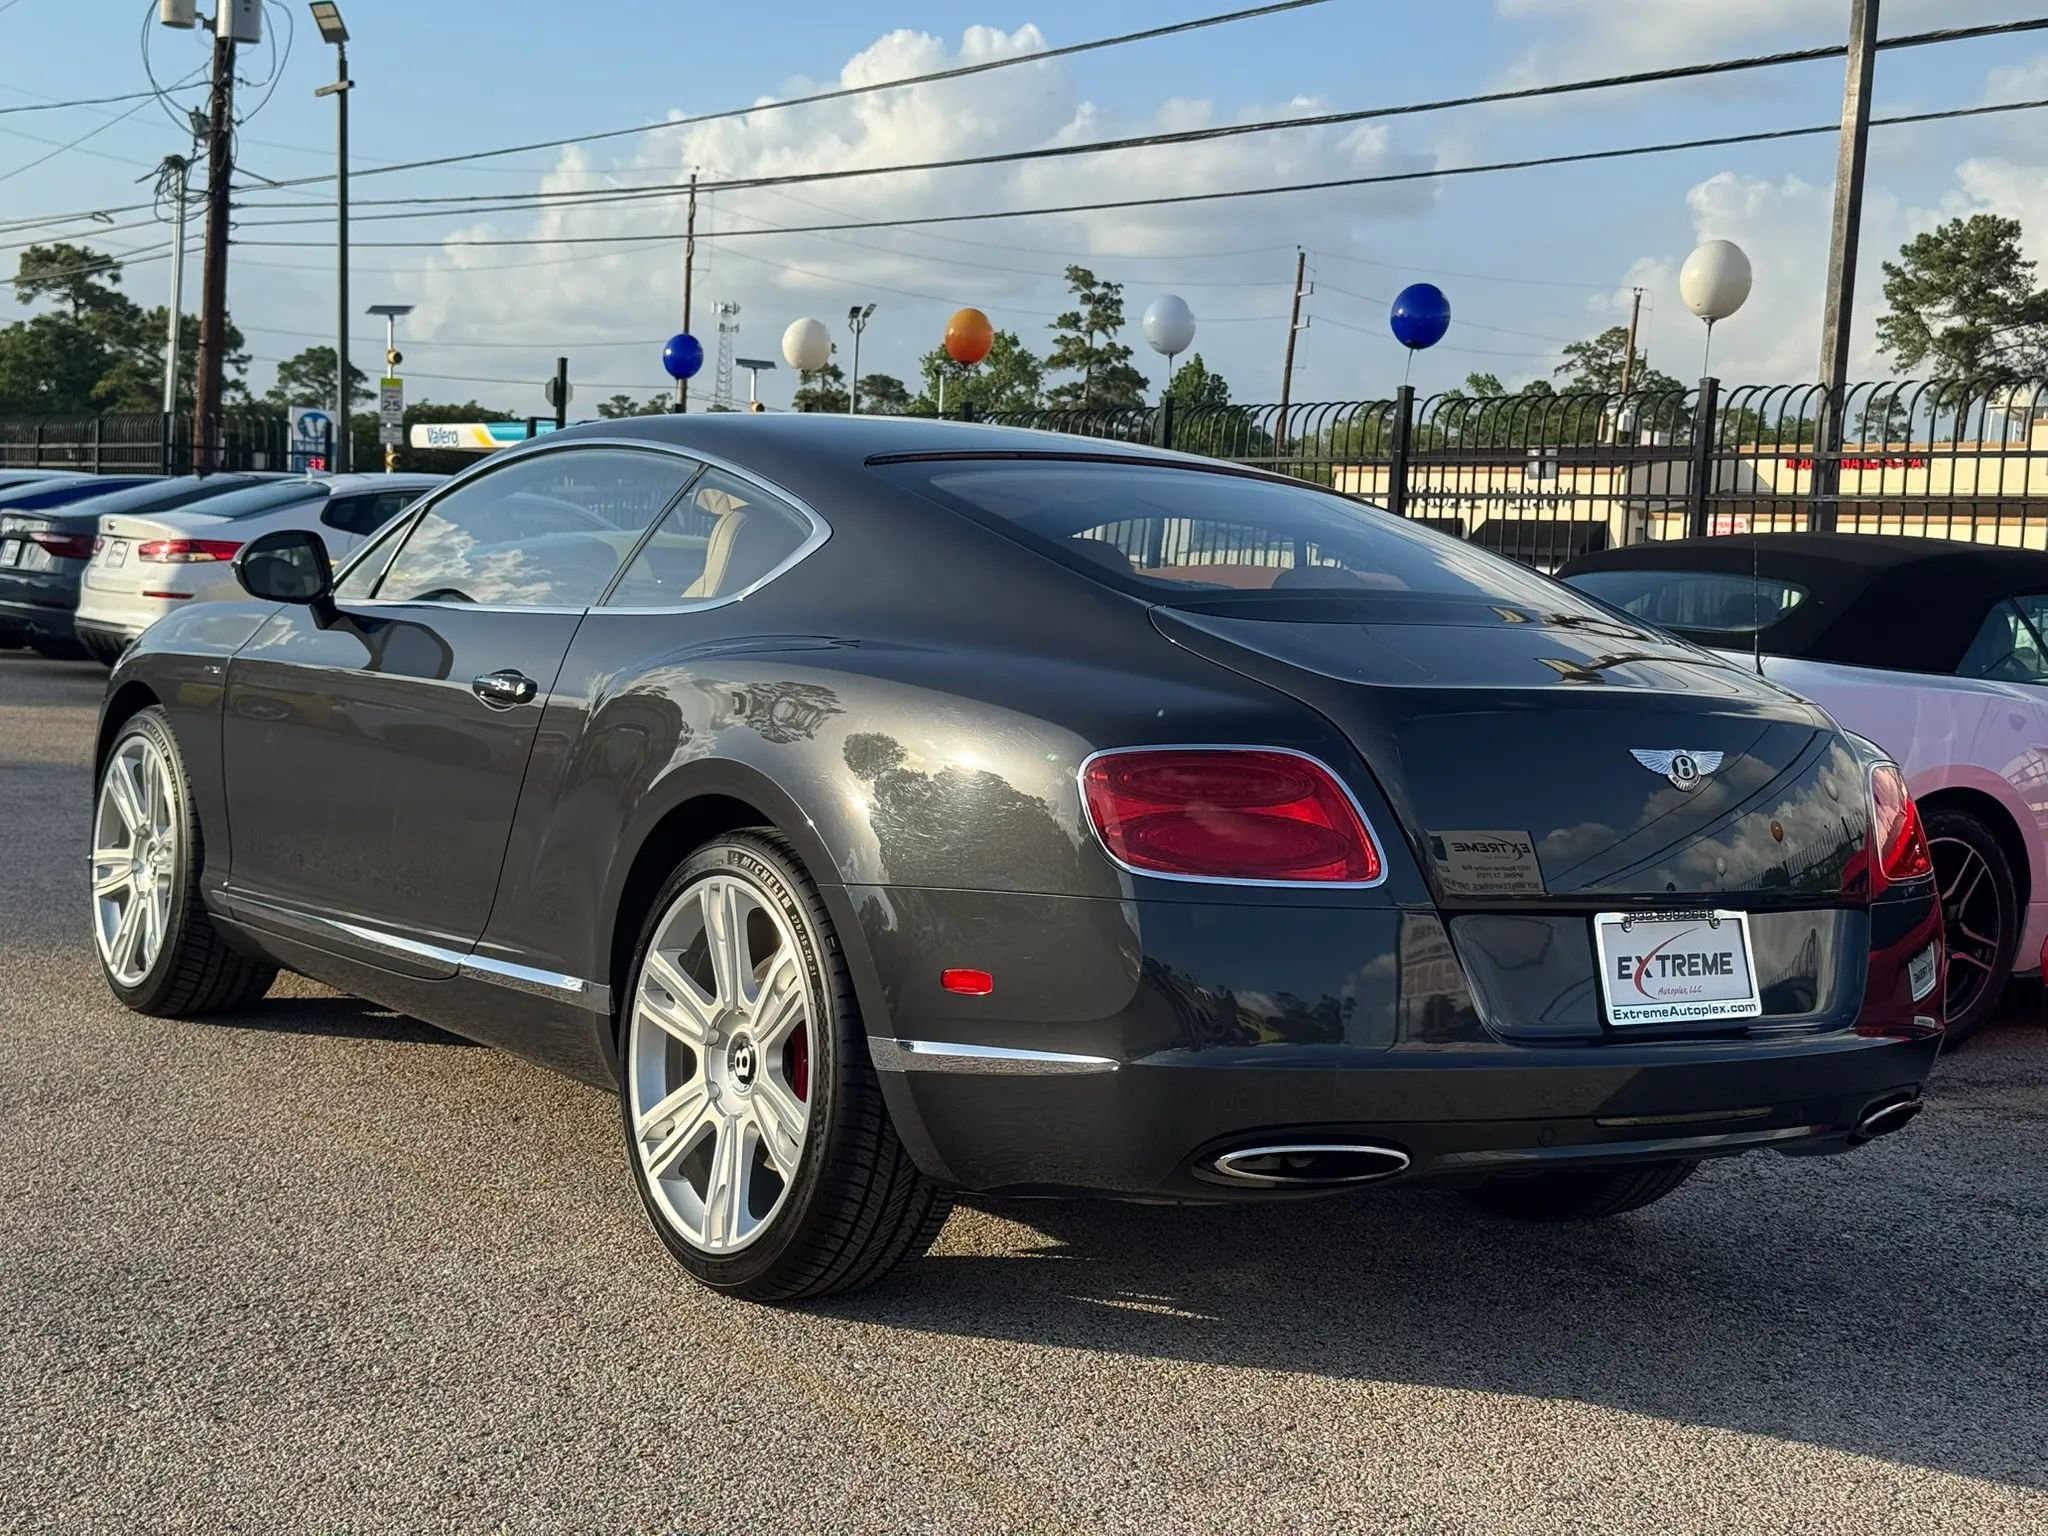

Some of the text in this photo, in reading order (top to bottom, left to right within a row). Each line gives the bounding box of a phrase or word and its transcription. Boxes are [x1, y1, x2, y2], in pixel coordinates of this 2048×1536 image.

[383, 400, 401, 412] 25
[427, 427, 459, 447] Valero
[740, 856, 793, 909] MICHELIN
[1617, 952, 1734, 980] EXTREME
[1689, 984, 1702, 994] LLC
[1612, 1003, 1757, 1020] ExtremeAutoplex.com
